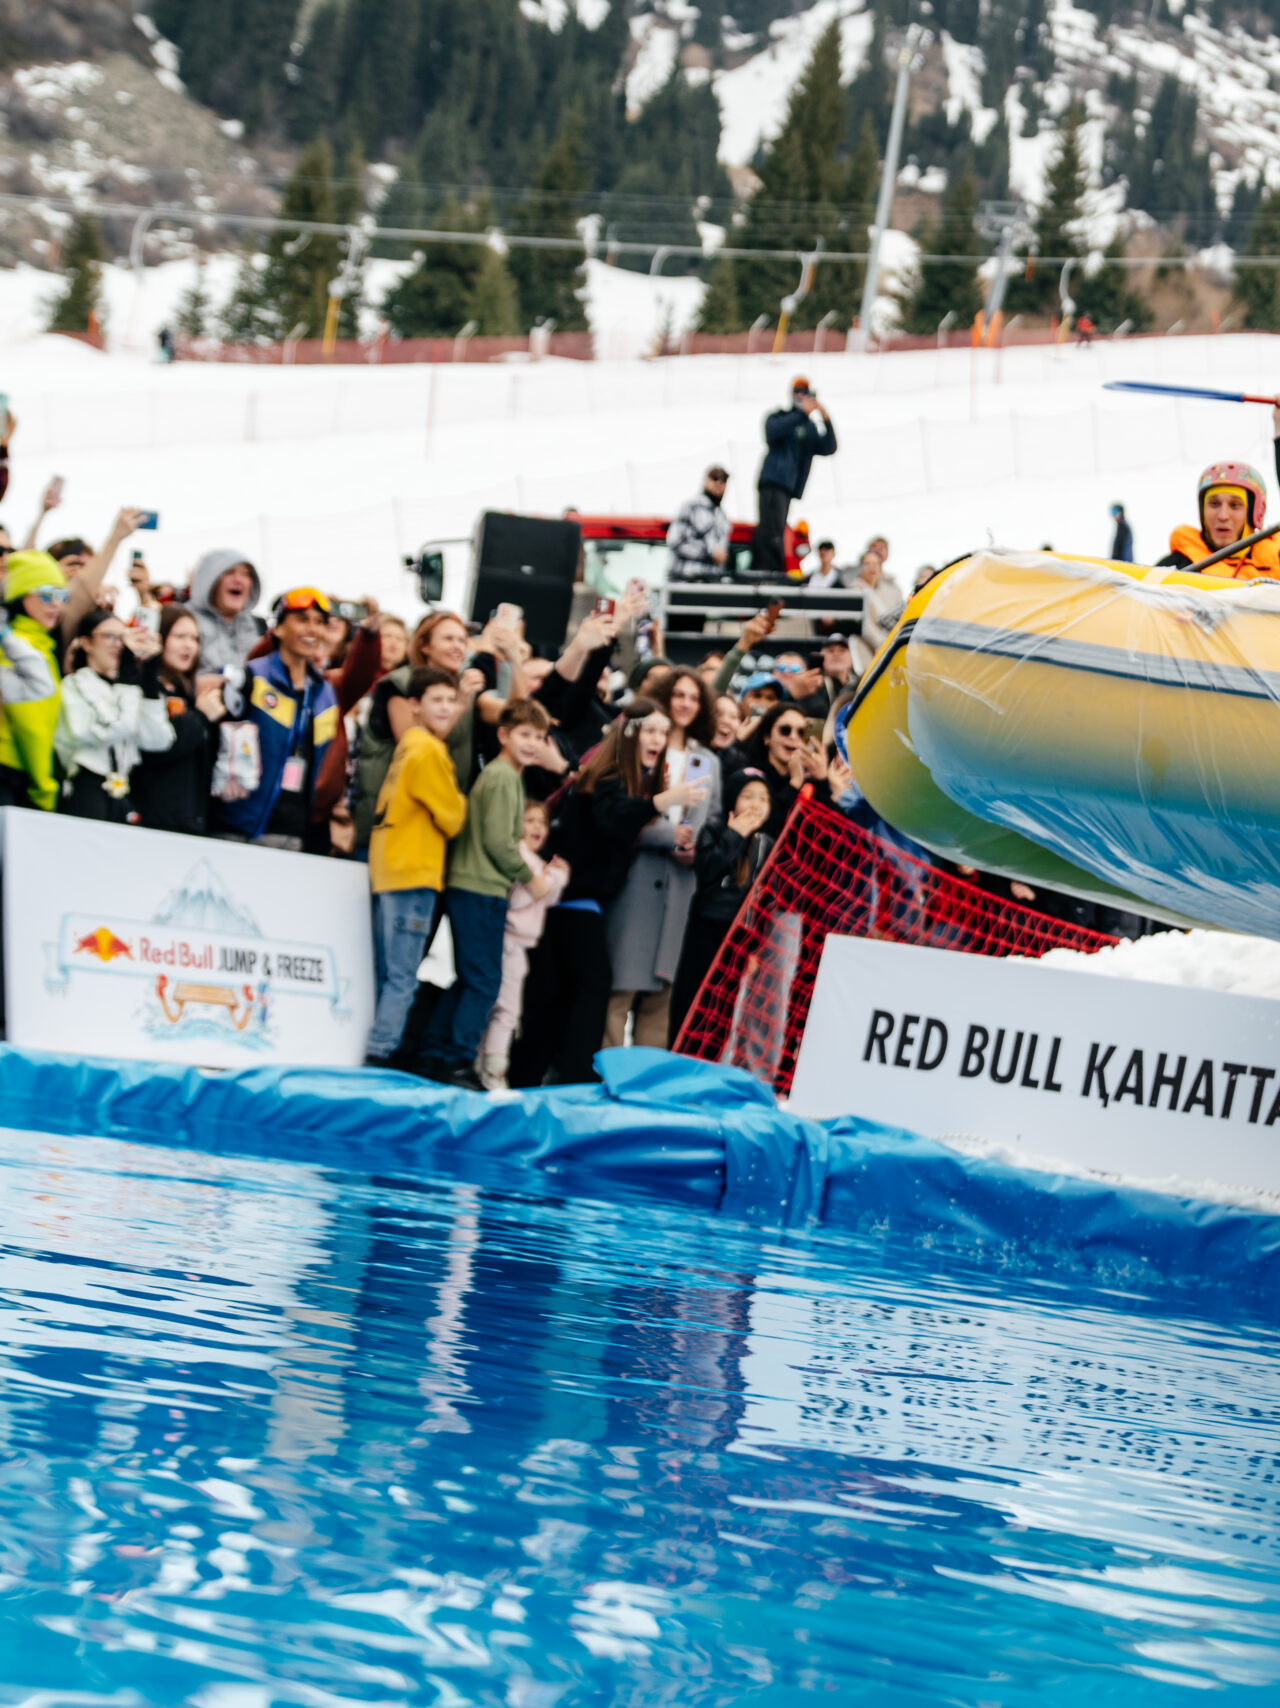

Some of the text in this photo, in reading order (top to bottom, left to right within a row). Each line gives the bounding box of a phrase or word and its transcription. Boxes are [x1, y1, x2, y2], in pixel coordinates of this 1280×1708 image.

[139, 937, 324, 983] Red Bull JUMP & FREEZE
[863, 1008, 949, 1072] RED
[959, 1023, 1062, 1093] BULL
